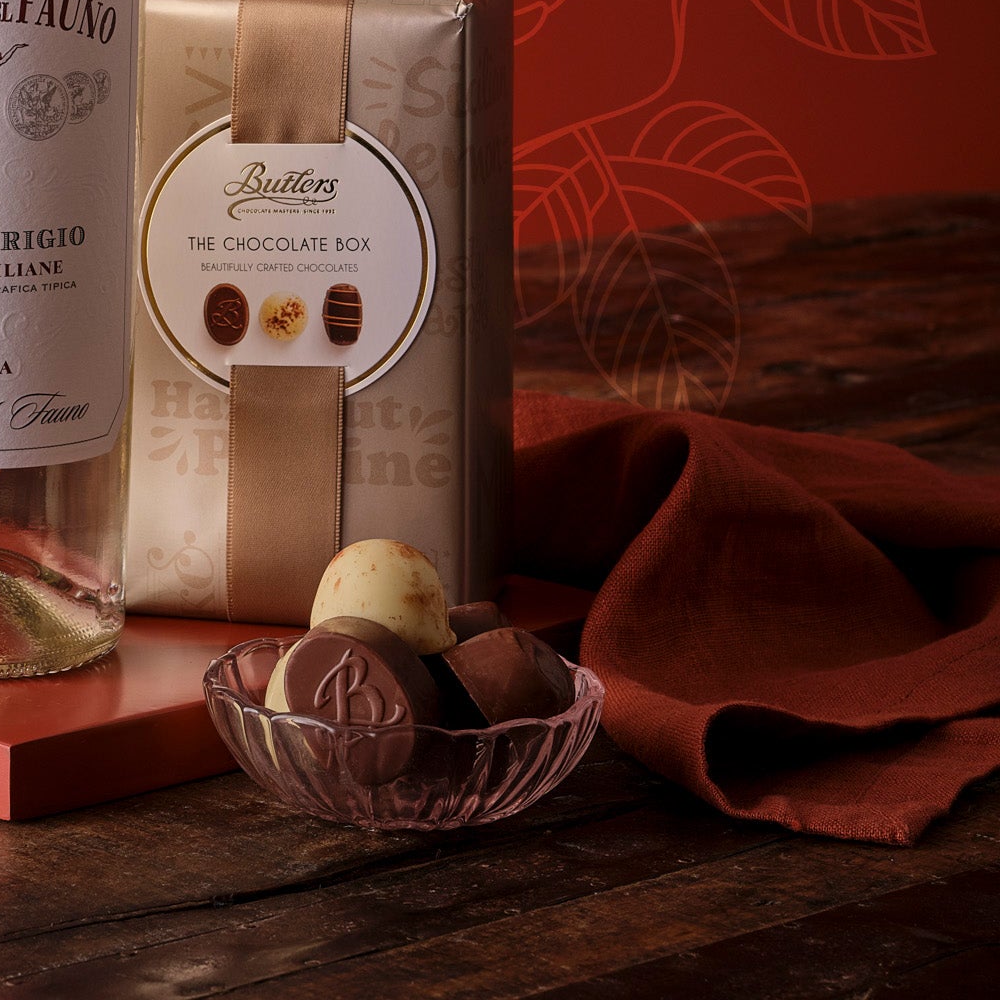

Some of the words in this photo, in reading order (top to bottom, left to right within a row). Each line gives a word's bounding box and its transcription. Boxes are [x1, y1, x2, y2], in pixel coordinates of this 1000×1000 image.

[223, 161, 340, 206] Butlers
[188, 236, 216, 252] THE
[223, 236, 328, 252] CHOCOLATE
[336, 236, 371, 252] BOX
[201, 262, 254, 272] BEAUTIFULLY
[256, 263, 294, 273] CRAFTED
[297, 263, 359, 273] CHOCOLATES
[41, 280, 77, 292] TIPICA
[8, 391, 91, 430] Fauno
